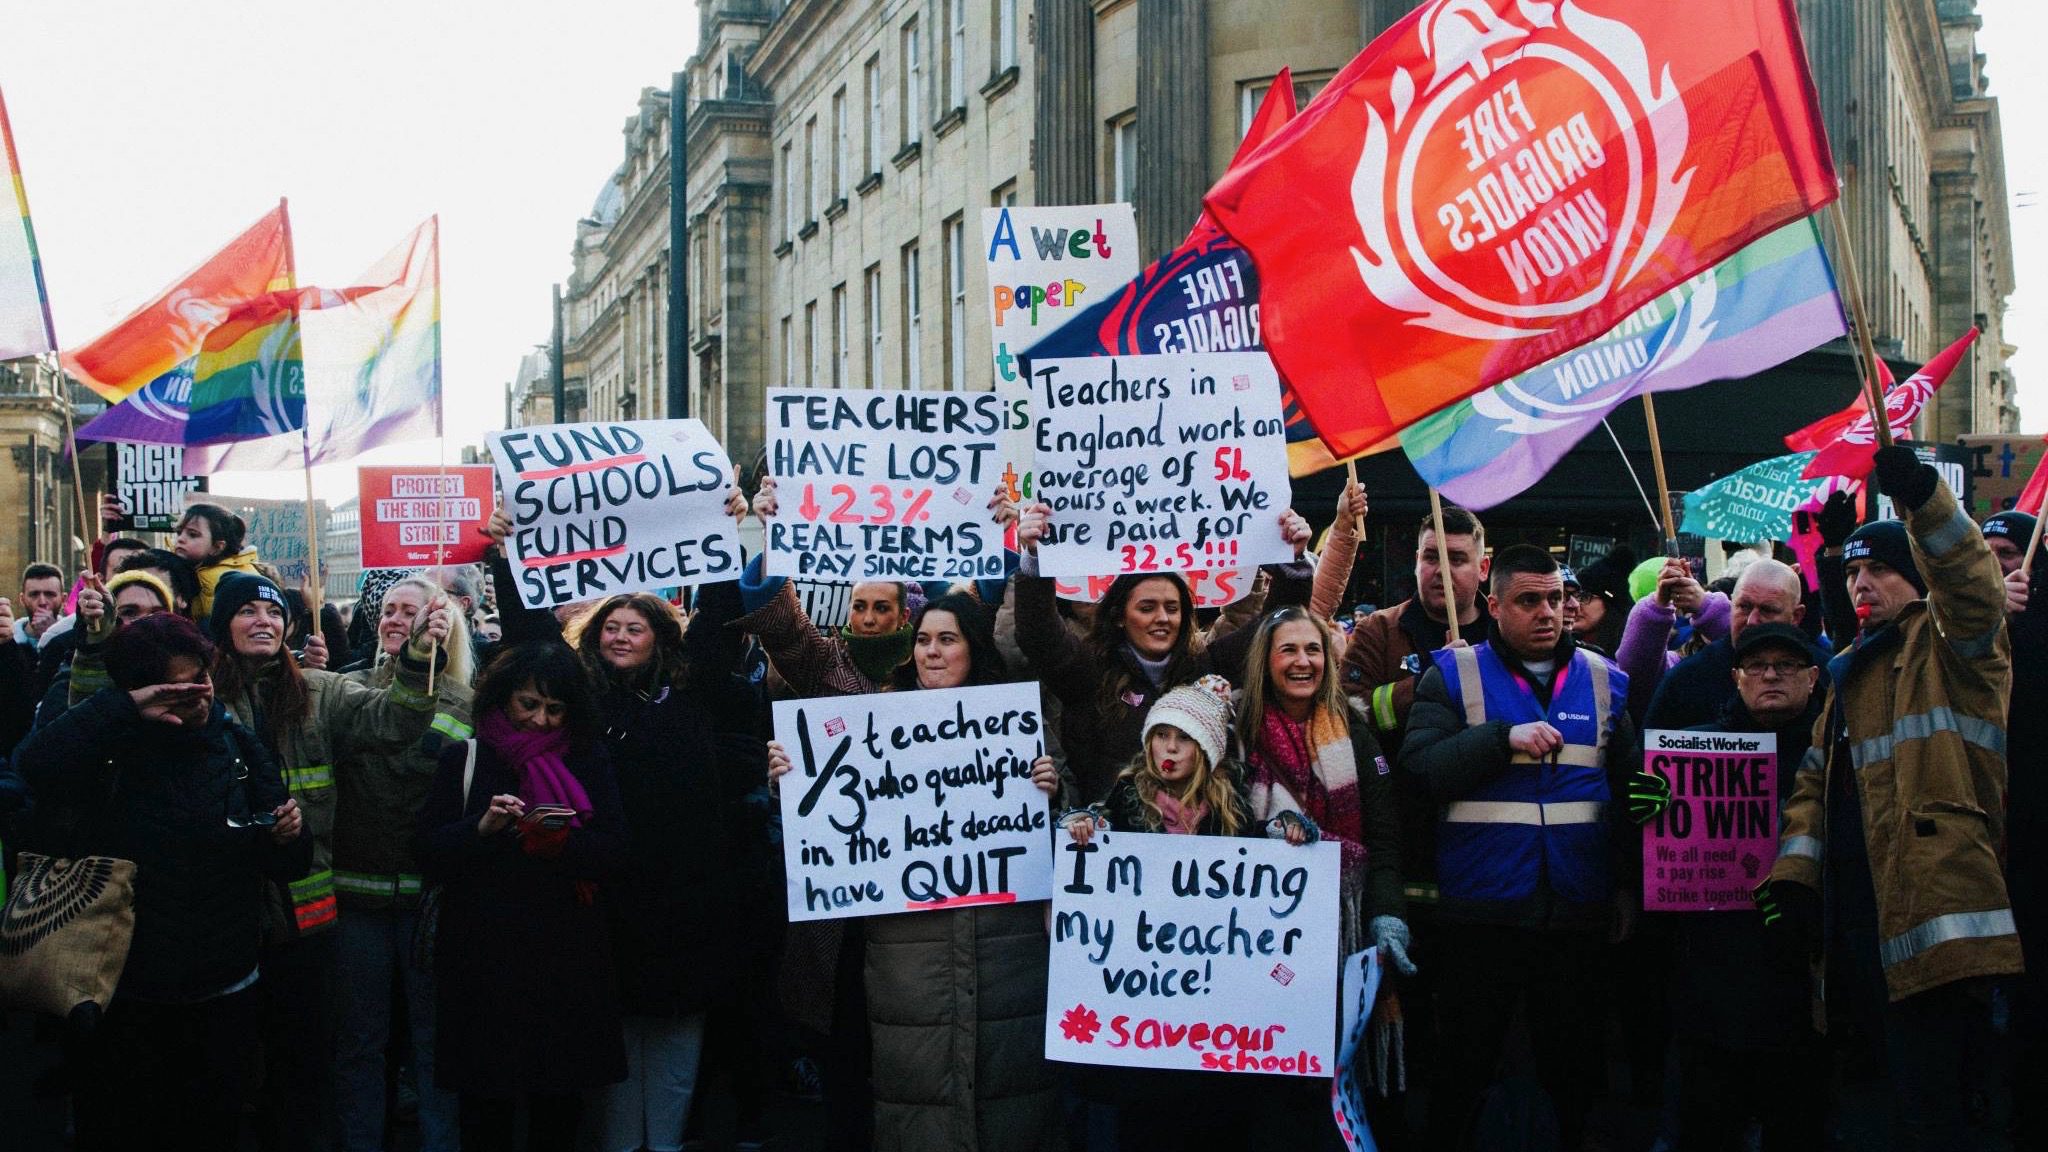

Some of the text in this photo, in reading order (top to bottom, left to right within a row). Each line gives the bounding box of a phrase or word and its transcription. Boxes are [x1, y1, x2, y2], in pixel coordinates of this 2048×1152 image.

[988, 208, 1112, 262] A wet
[993, 278, 1087, 327] paper
[1035, 358, 1171, 409] Teachers
[1190, 368, 1216, 395] in
[773, 394, 1000, 435] TEACHERS
[1003, 400, 1029, 430] is
[500, 426, 644, 473] FUND
[1036, 402, 1165, 469] England
[1178, 405, 1246, 444] work
[117, 442, 195, 482] RIGH
[774, 438, 996, 485] HAVE LOST
[1039, 446, 1251, 497] average of 54
[396, 478, 460, 494] PROTECT
[515, 452, 731, 525] SCHOOLS.
[828, 483, 934, 525] 23%
[1037, 481, 1270, 516] hours a week. We
[382, 502, 408, 519] THE
[459, 501, 476, 517] TO
[405, 526, 455, 542] STRIE
[516, 516, 627, 560] FUND
[771, 522, 983, 556] REAL TERMS
[1038, 513, 1252, 550] are paid for
[522, 534, 739, 605] SERVICES.
[799, 552, 1002, 578] PAY SINCE 2010
[861, 700, 1039, 760] teachers
[1658, 734, 1761, 752] Socialist Worker
[865, 760, 918, 801] who
[1651, 754, 1769, 797] STRIKE
[800, 802, 1046, 867] in the last decade
[1704, 800, 1770, 840] WIN
[1656, 865, 1726, 882] a pay rise
[1657, 845, 1737, 863] We all need
[805, 846, 1027, 912] have QUIT
[1063, 834, 1308, 920] I'm using
[1657, 887, 1698, 903] Strike
[1136, 906, 1302, 959] teacher
[1103, 959, 1212, 999] voice!
[1201, 1048, 1322, 1074] schools
